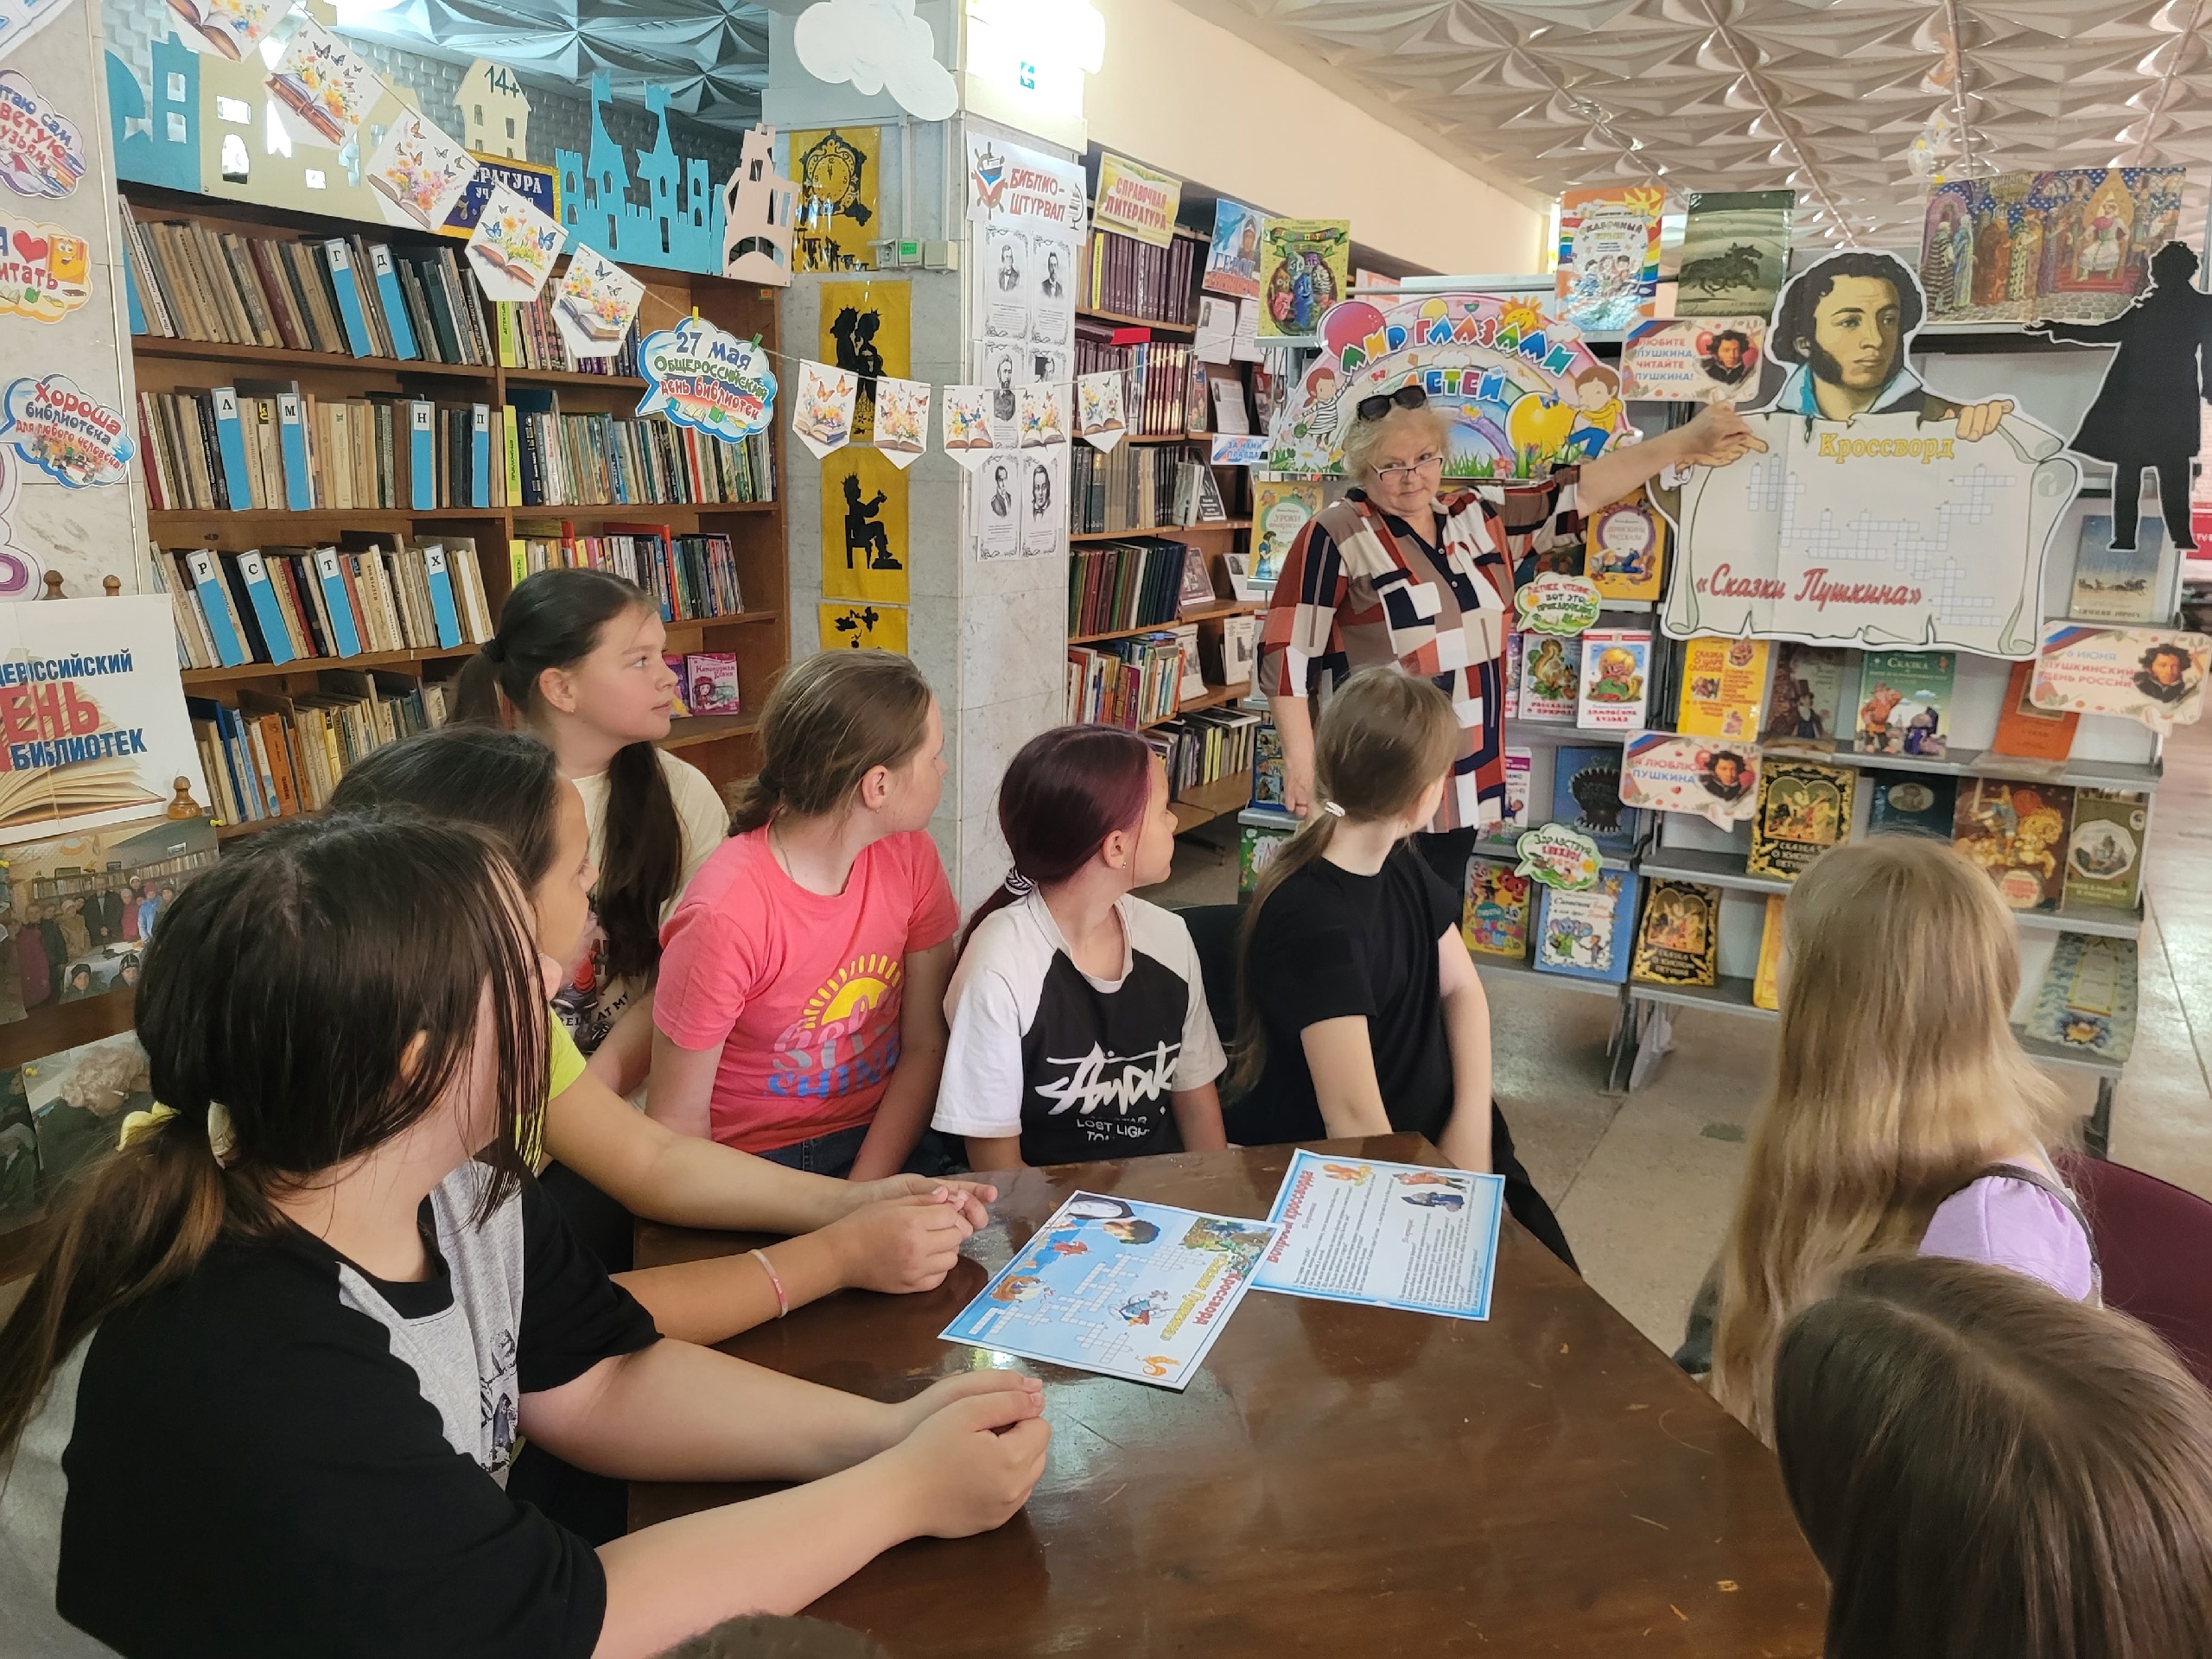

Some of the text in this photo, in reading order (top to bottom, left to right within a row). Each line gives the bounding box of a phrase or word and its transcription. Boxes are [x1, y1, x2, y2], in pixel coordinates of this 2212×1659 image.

[484, 66, 520, 99] 14+
[0, 85, 37, 115] таю
[0, 102, 67, 159] ветую
[0, 124, 47, 166] узьям
[471, 166, 543, 194] ЕРАТУРА
[1009, 168, 1065, 196] БИБЛИО-
[1116, 176, 1167, 210] СПРАВОЧНАЯ
[1104, 195, 1167, 231] ЛИТЕРАТУРА
[377, 254, 388, 269] Д
[0, 262, 59, 289] итать
[676, 331, 703, 357] 27
[1340, 315, 1579, 378] МИР ГЛАЗАМИ
[1636, 349, 1696, 359] ПУШКИНА,
[1637, 338, 1685, 346] ЛЮБИТЕ
[1635, 372, 1694, 381] ПУШКИНА!
[1636, 359, 1685, 369] ЧИТАЙТЕ
[35, 382, 122, 436] Хороша
[222, 398, 232, 410] Л
[285, 405, 296, 416] М
[694, 376, 760, 420] библиотек
[26, 401, 111, 446] библиотека
[417, 412, 427, 423] Н
[477, 414, 485, 424] П
[38, 423, 75, 442] любого
[78, 436, 125, 471] человека!
[1227, 451, 1260, 460] ПРАВДА
[1818, 433, 1955, 465] Кроссворд
[1696, 563, 1923, 613] «Сказки Пушкина»
[2045, 660, 2135, 676] ПУШКИНСКИЙ
[2077, 651, 2116, 661] ИЮНЯ
[2043, 672, 2133, 688] ДЕНЬ РОССИИ
[0, 681, 100, 769] ЕНЬ
[10, 728, 148, 771] БИБЛИОТЕК
[1632, 769, 1695, 784] ПУШКИНА
[1645, 758, 1698, 772] ЛЮБЛЮ
[1077, 1119, 1150, 1139] LOST LIGH
[1192, 1270, 1243, 1325] Кроссворд
